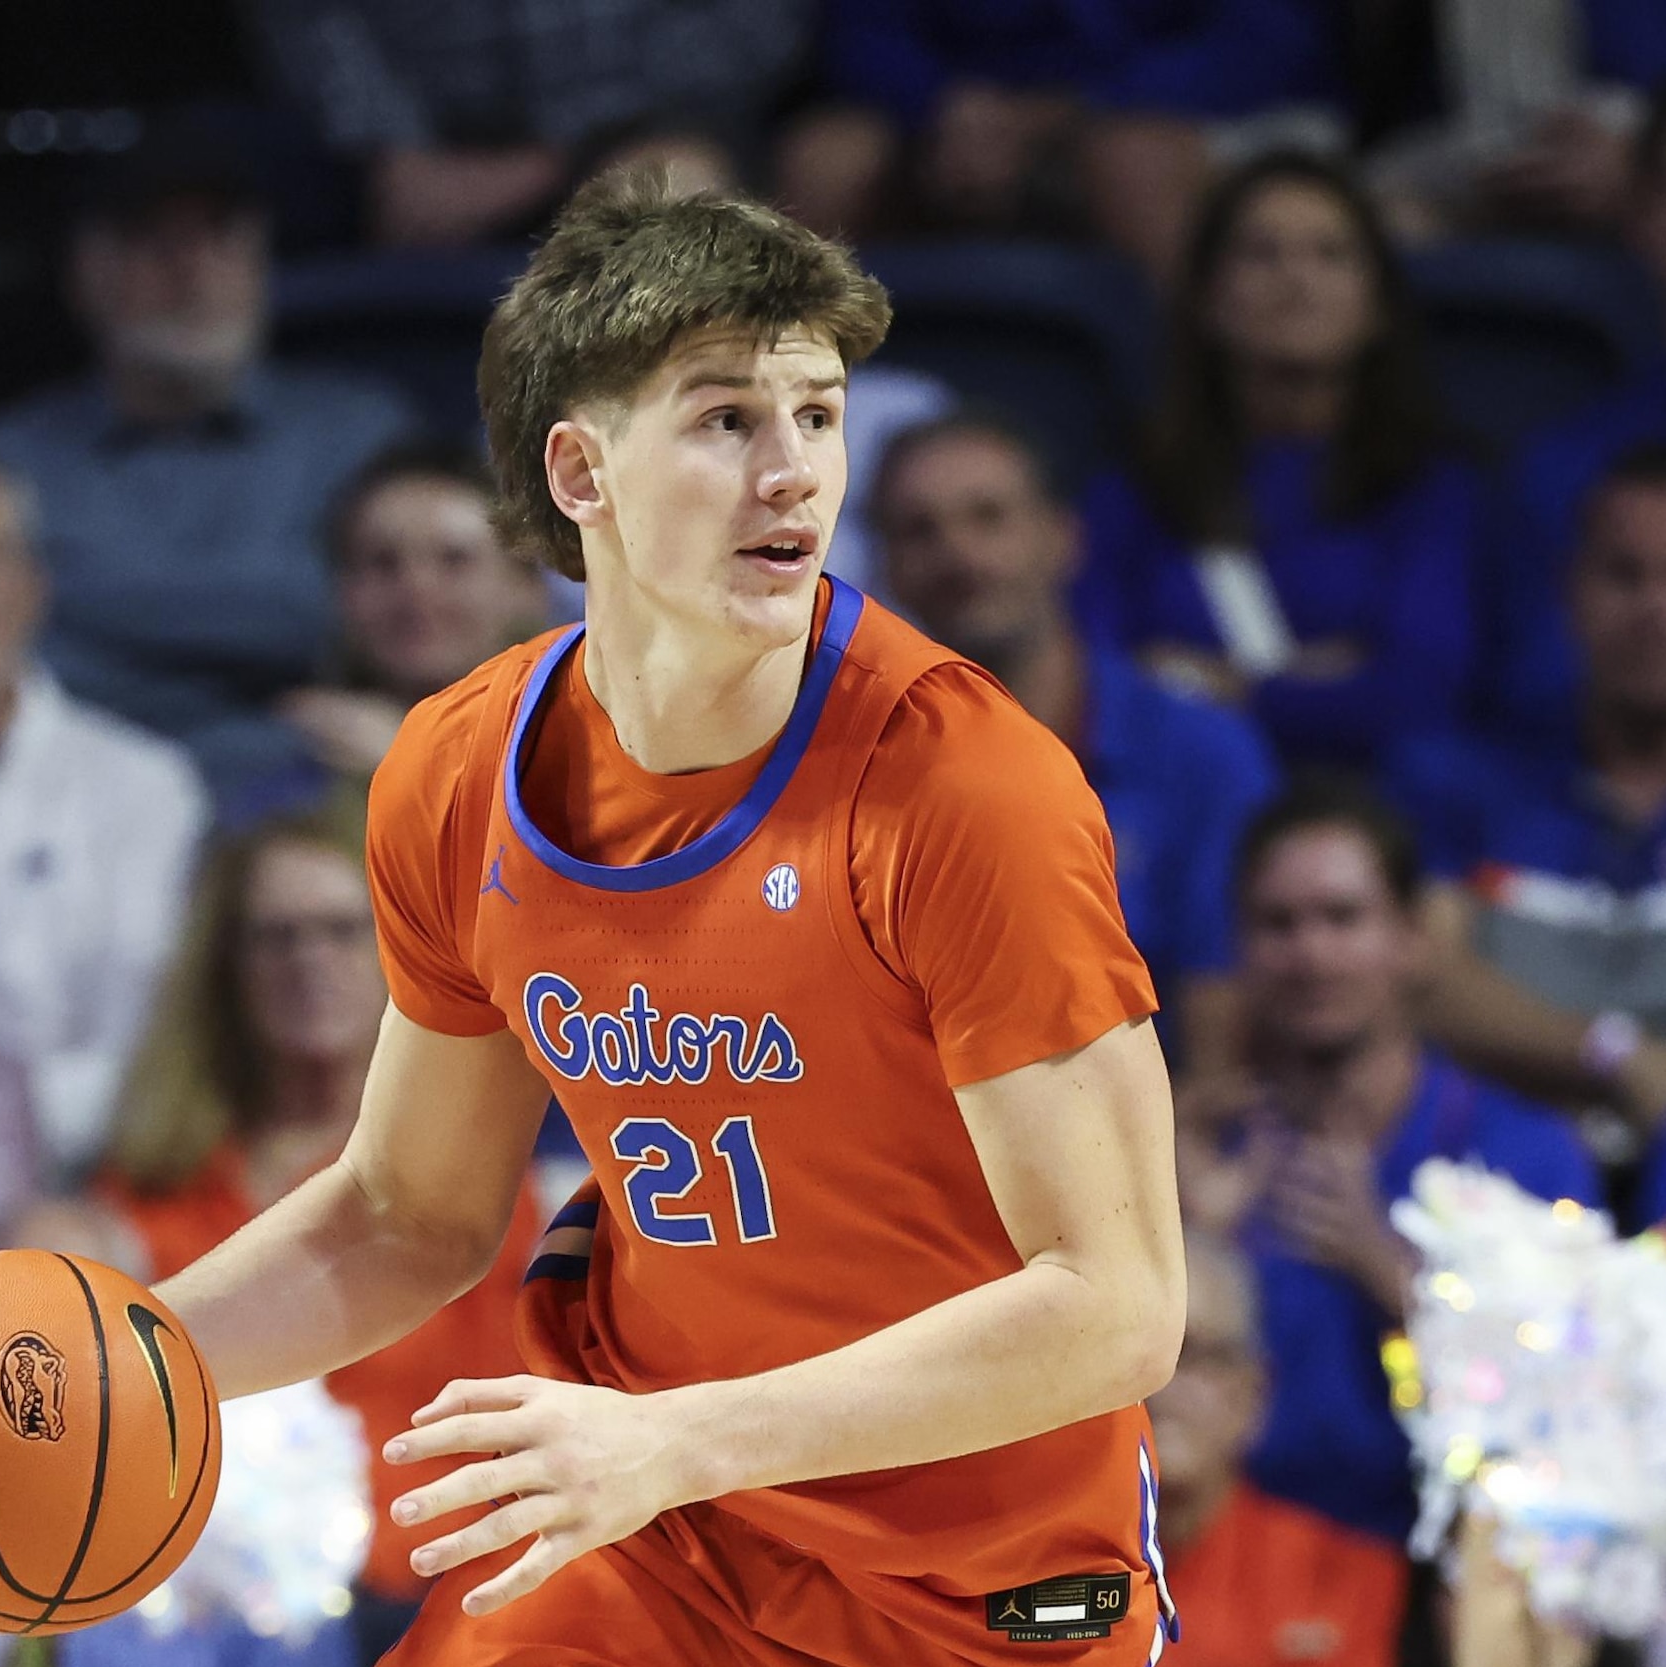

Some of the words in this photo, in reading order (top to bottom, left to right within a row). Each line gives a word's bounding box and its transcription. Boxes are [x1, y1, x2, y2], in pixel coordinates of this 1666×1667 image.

[763, 865, 798, 910] SEC
[523, 972, 804, 1086] Gators
[609, 1114, 777, 1247] 21
[1096, 1589, 1120, 1610] 50
